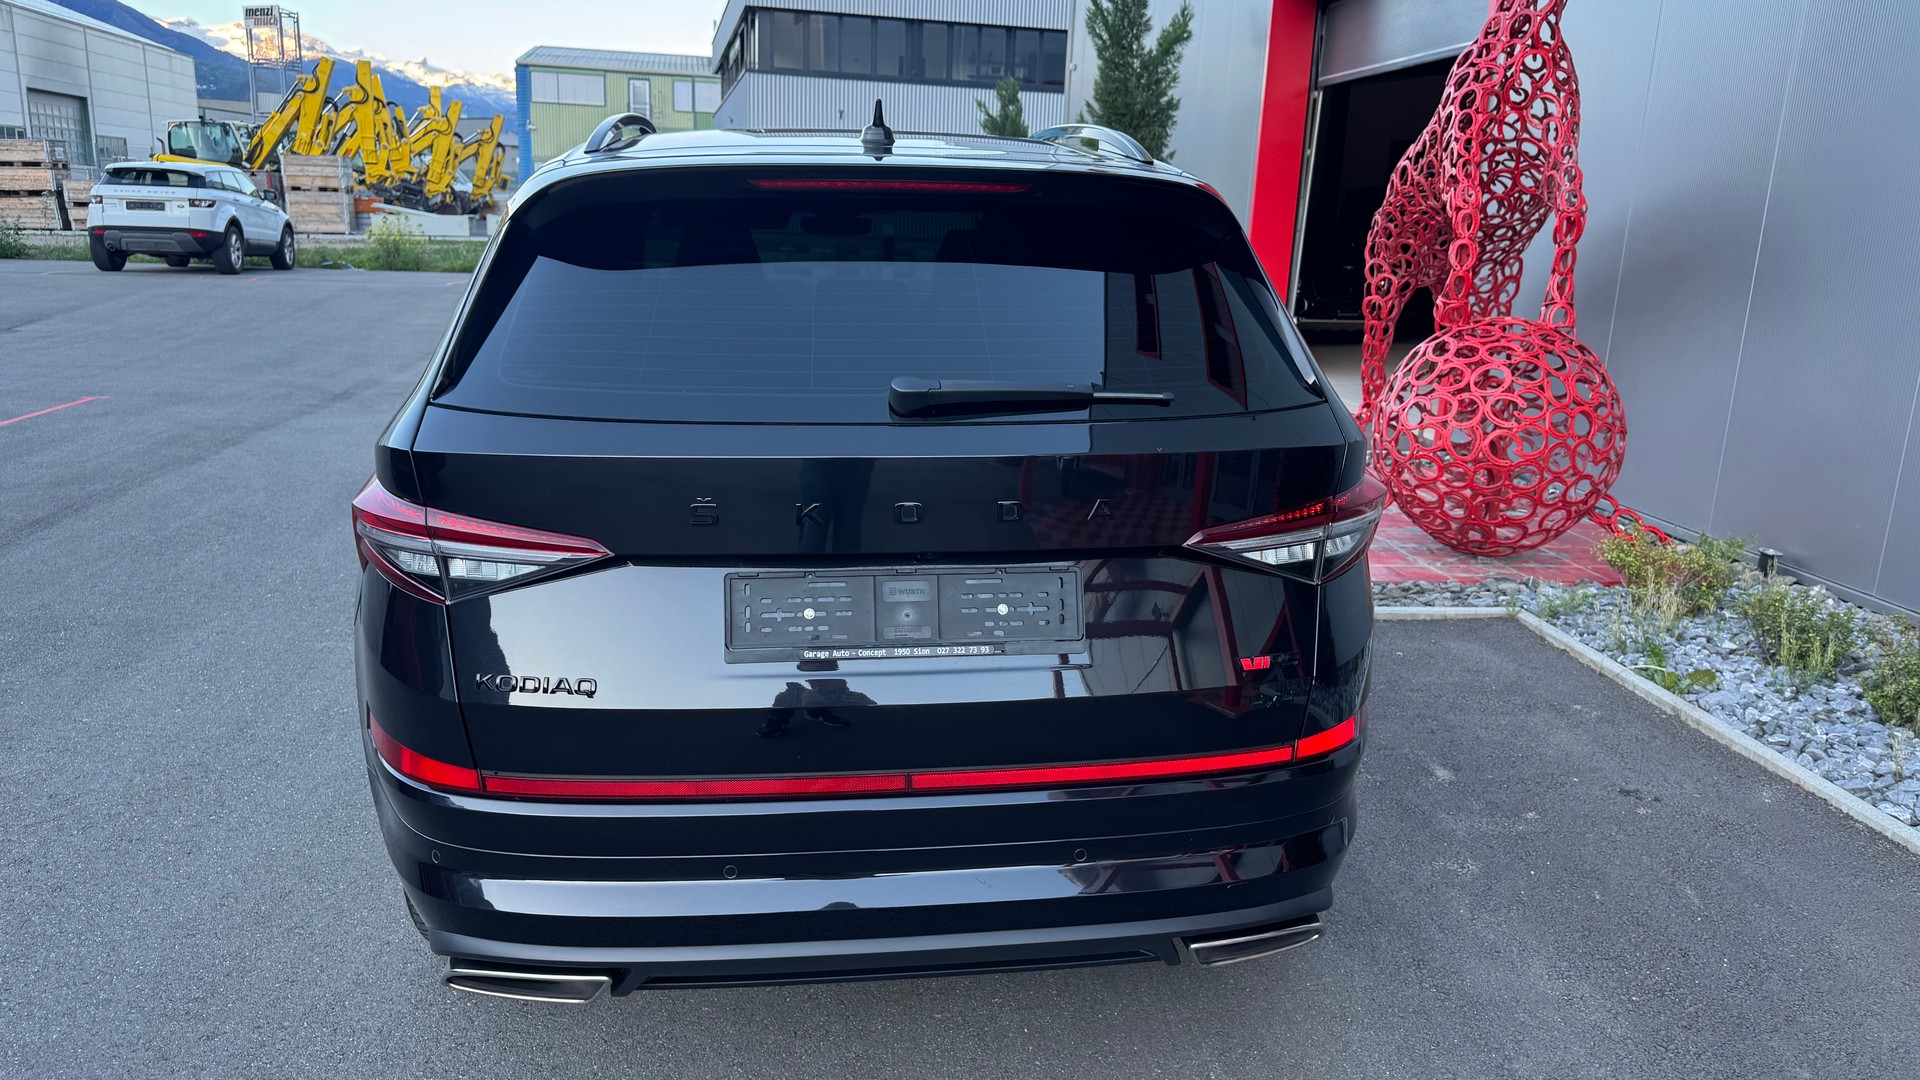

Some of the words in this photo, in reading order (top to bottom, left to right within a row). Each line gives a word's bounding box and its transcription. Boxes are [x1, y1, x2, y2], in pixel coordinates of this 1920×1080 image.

[245, 5, 273, 17] menzi
[690, 497, 1112, 526] ŠKODA
[803, 650, 829, 659] Garage
[832, 649, 850, 657] Auto
[858, 648, 886, 657] Concept
[894, 648, 911, 656] 1950
[913, 647, 930, 655] Sion
[936, 647, 950, 655] 027
[953, 646, 966, 654] 322
[969, 646, 978, 654] 73
[475, 673, 598, 698] KODIAQ
